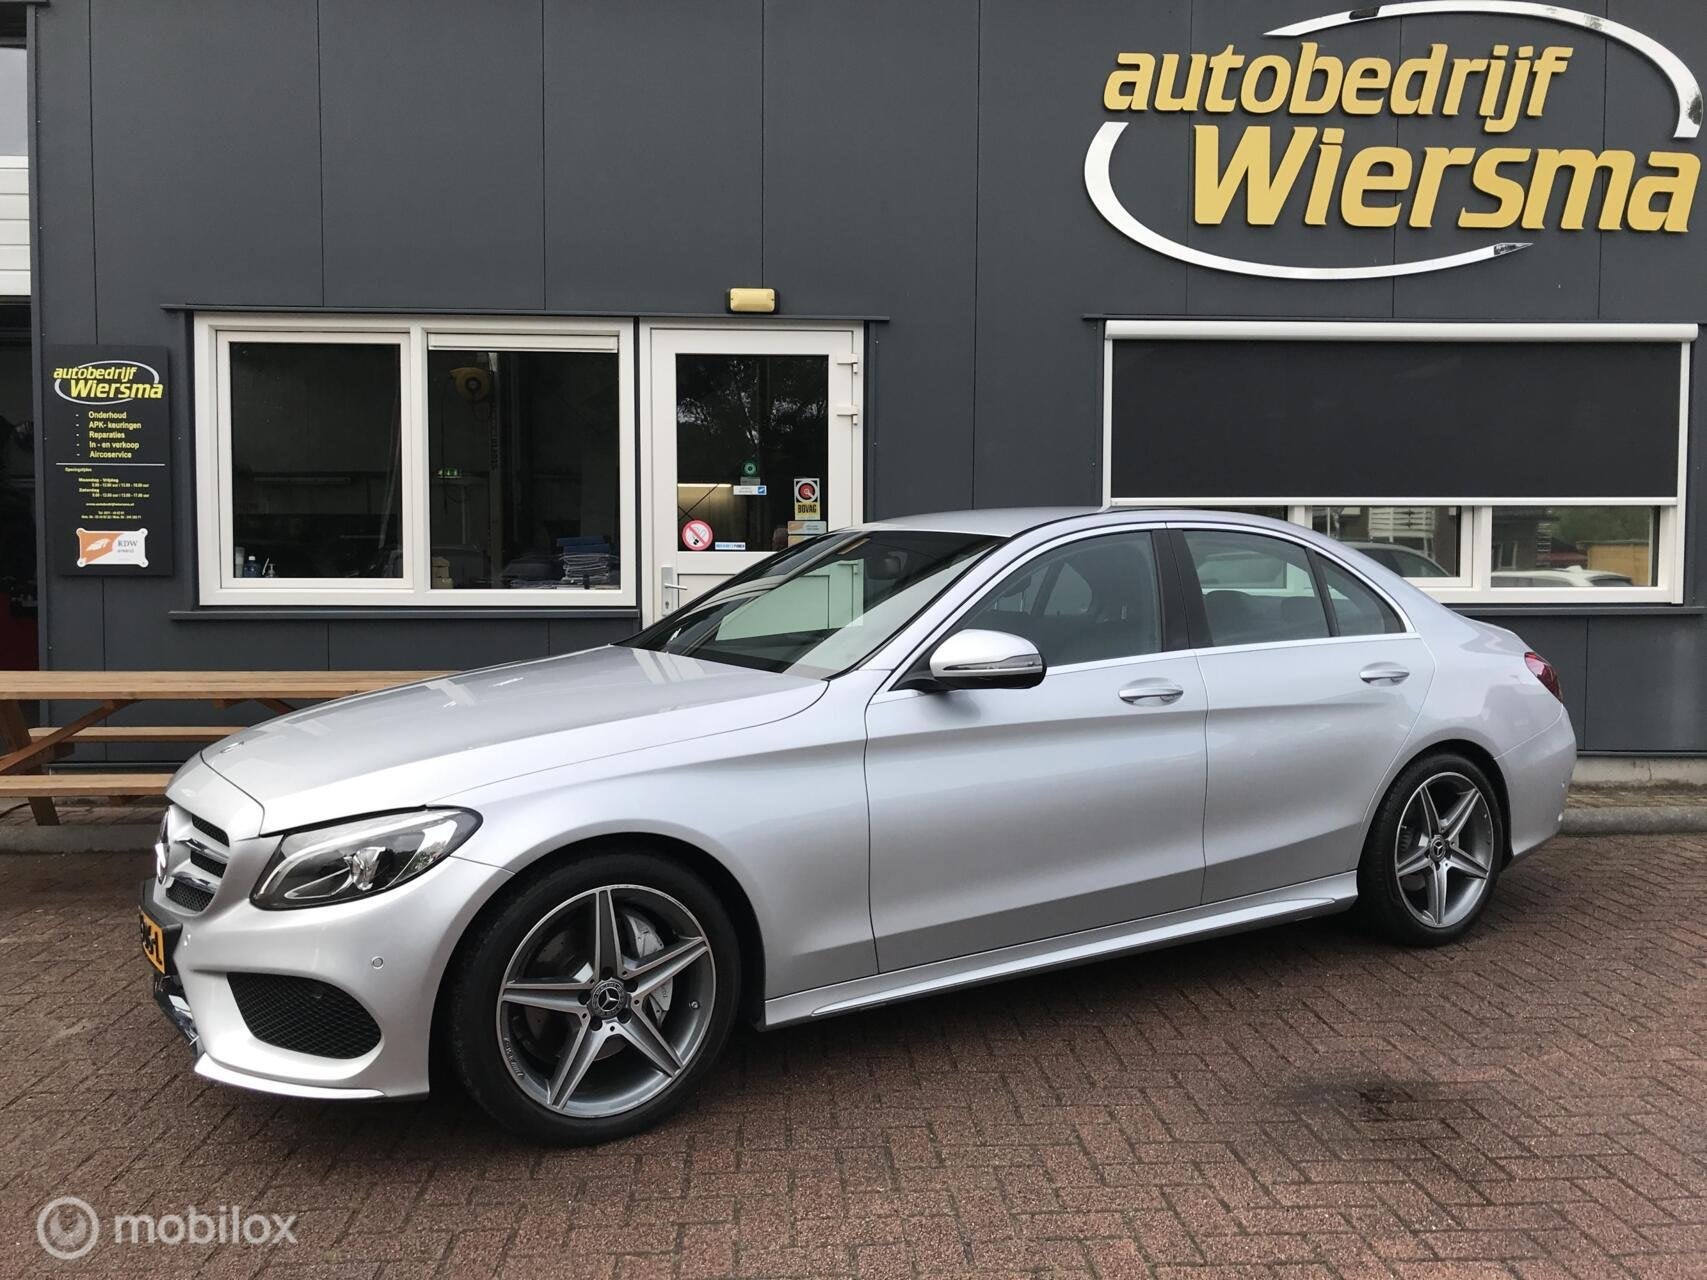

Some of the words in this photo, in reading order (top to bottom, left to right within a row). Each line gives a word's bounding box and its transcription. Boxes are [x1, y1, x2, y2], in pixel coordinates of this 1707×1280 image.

[1103, 42, 1573, 134] autobedrijf
[1192, 124, 1702, 234] Wiersma
[53, 366, 138, 382] autobedrijf
[70, 379, 164, 399] Wiersma
[88, 411, 127, 419] Onderhoud
[107, 421, 141, 430] keuringen
[89, 431, 125, 440] Reparaties
[112, 441, 140, 449] verkoop
[797, 504, 817, 514] BOVAG
